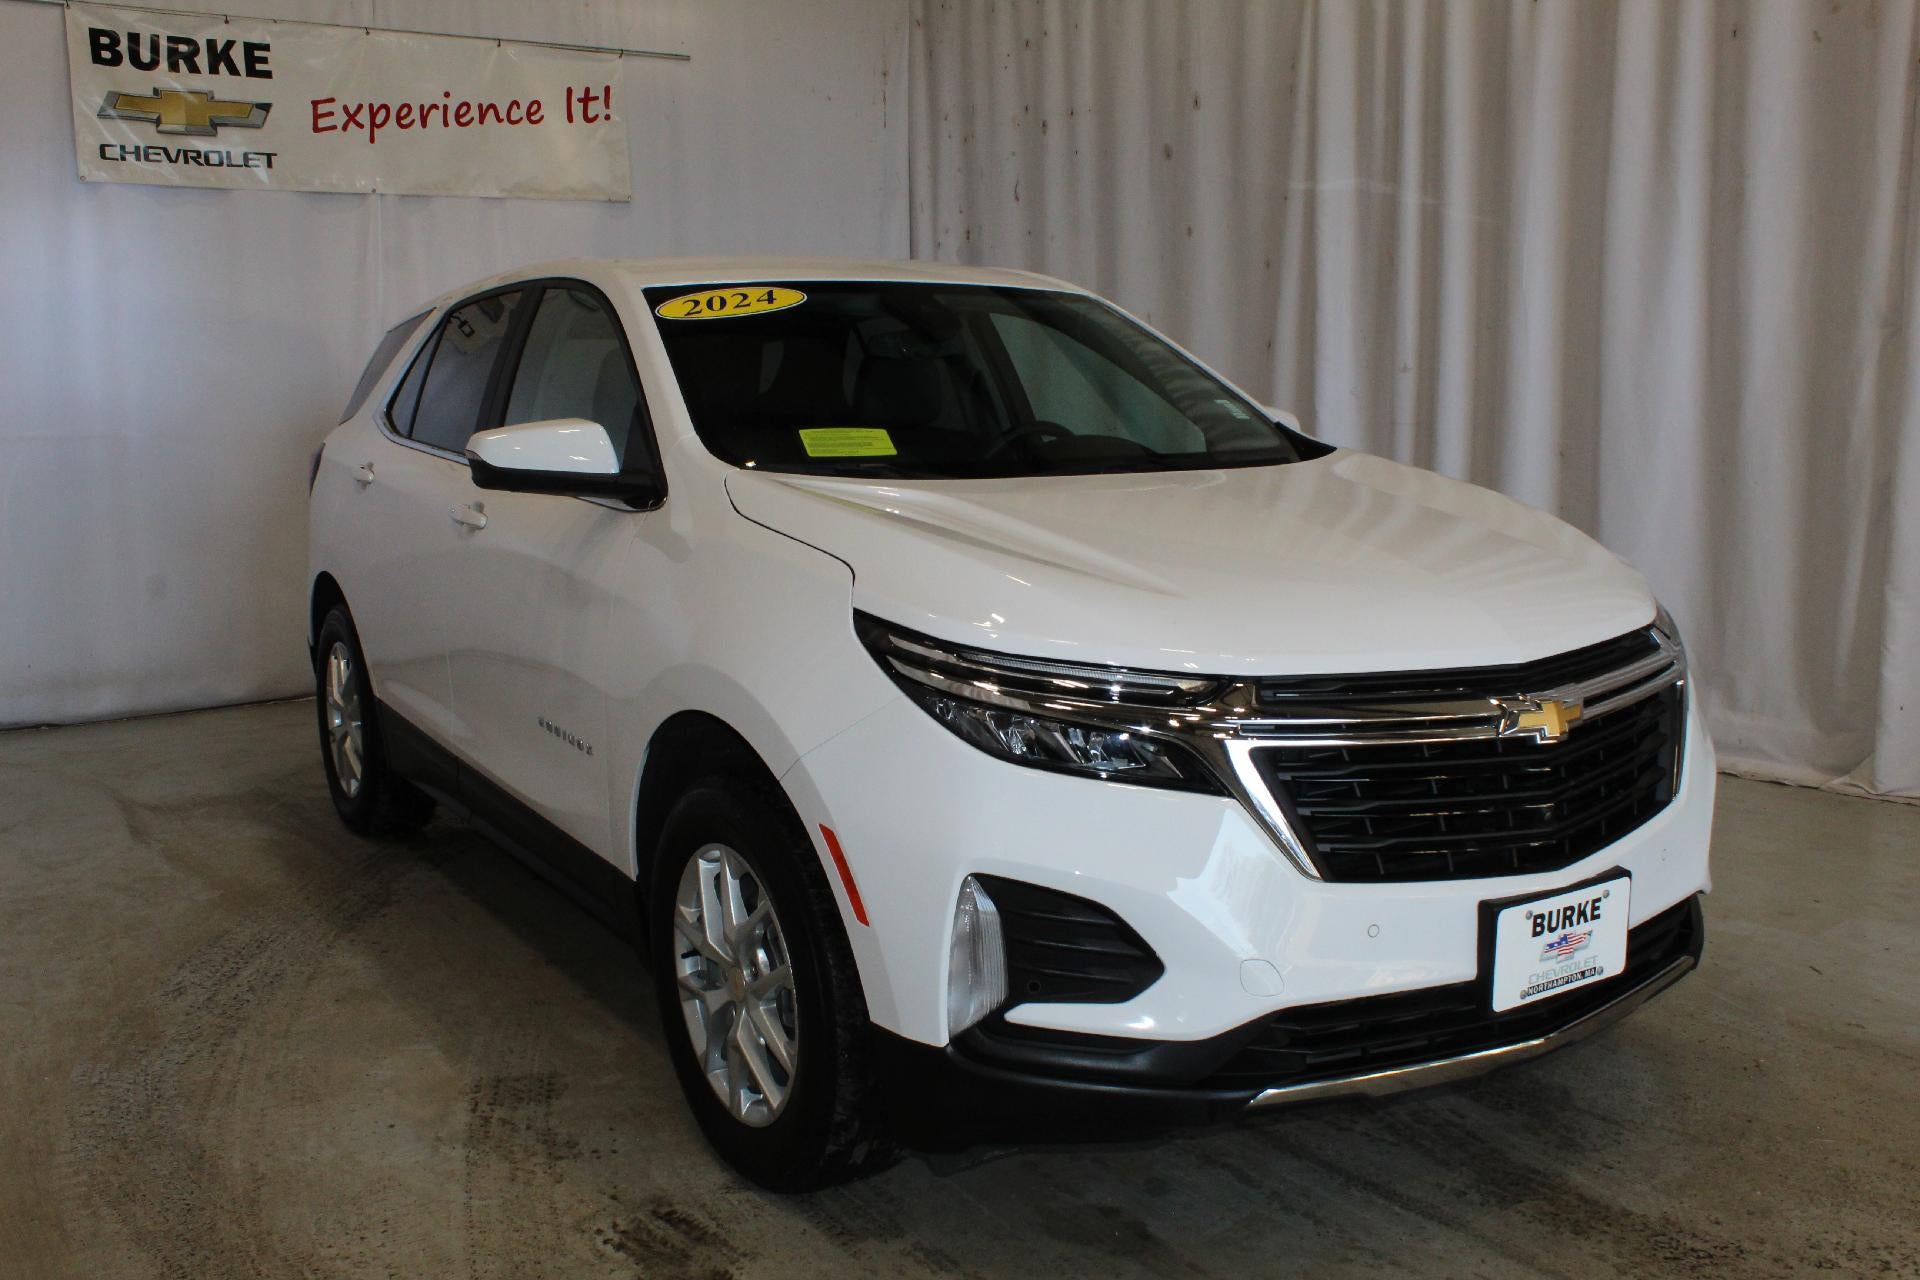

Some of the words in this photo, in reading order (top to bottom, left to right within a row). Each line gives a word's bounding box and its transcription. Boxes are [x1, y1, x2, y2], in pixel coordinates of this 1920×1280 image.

[88, 27, 274, 79] BURKE
[310, 91, 545, 143] Experience
[565, 85, 614, 125] It!
[99, 143, 277, 169] CHEVROLET
[682, 289, 777, 316] 2024
[1532, 897, 1602, 937] BURKE
[1529, 956, 1598, 984] CHEVROLET
[1585, 968, 1596, 977] MA
